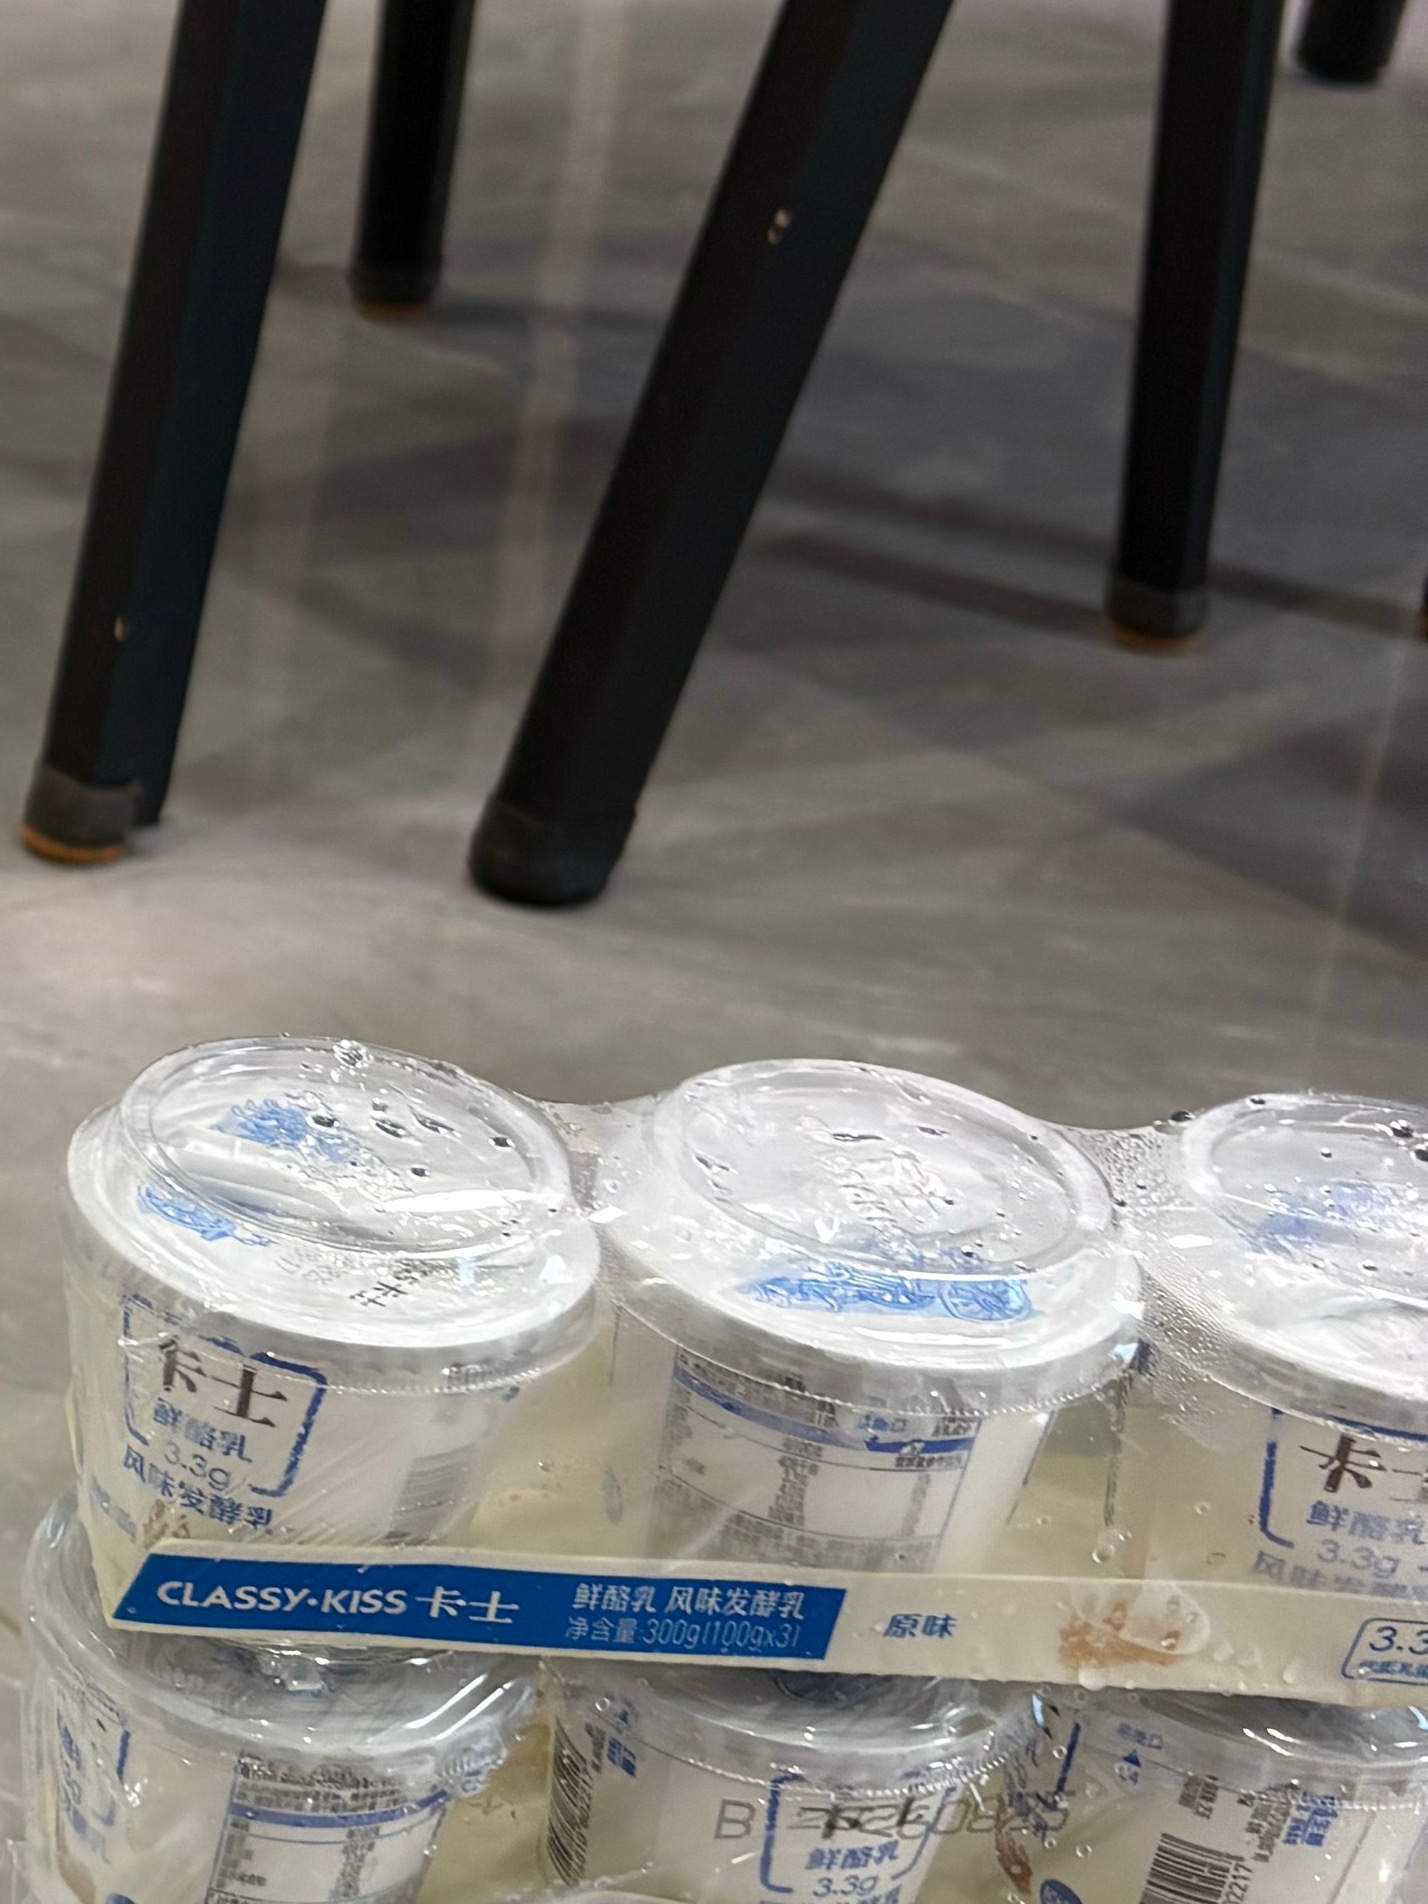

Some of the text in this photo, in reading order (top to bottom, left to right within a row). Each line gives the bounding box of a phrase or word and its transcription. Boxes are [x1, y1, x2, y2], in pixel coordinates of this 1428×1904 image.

[156, 1338, 288, 1429] 卡士
[153, 1397, 252, 1463] 鲜酪乳
[164, 1441, 230, 1493] 3.3g
[123, 1444, 274, 1530] 风味发酵乳
[1317, 1539, 1400, 1579] 3.3g
[416, 1585, 521, 1624] 卡士
[572, 1582, 805, 1621] 鲜酪乳 风味发酵乳
[882, 1612, 957, 1639] 原味
[804, 1839, 900, 1871] 鲜酪乳
[812, 1875, 878, 1898] 3.3g
